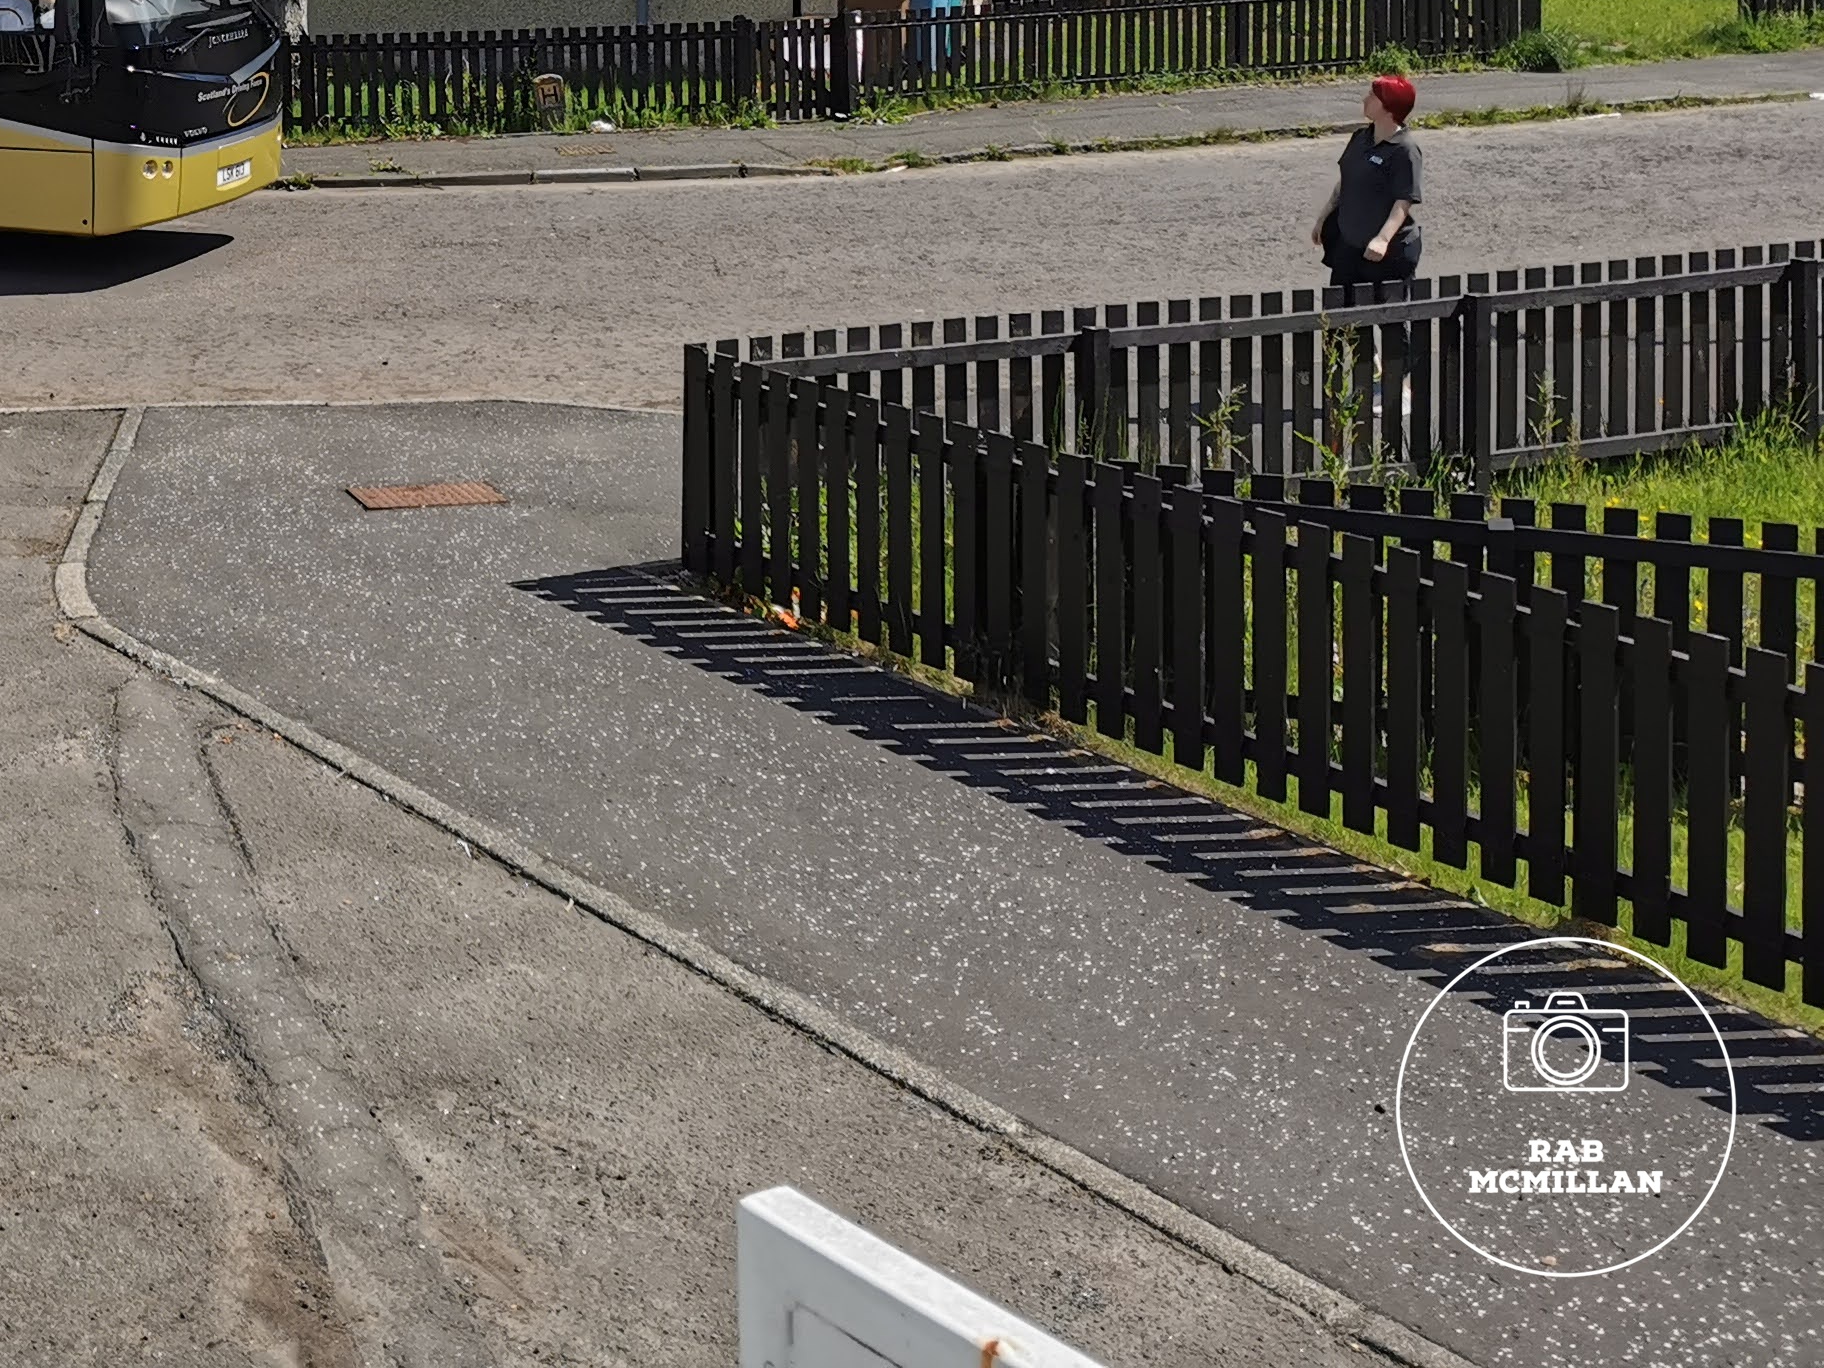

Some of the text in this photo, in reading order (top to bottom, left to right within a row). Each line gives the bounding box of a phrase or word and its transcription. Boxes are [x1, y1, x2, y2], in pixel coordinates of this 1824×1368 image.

[197, 86, 231, 102] Scotland's
[540, 85, 558, 105] H
[183, 126, 208, 138] VOLVO
